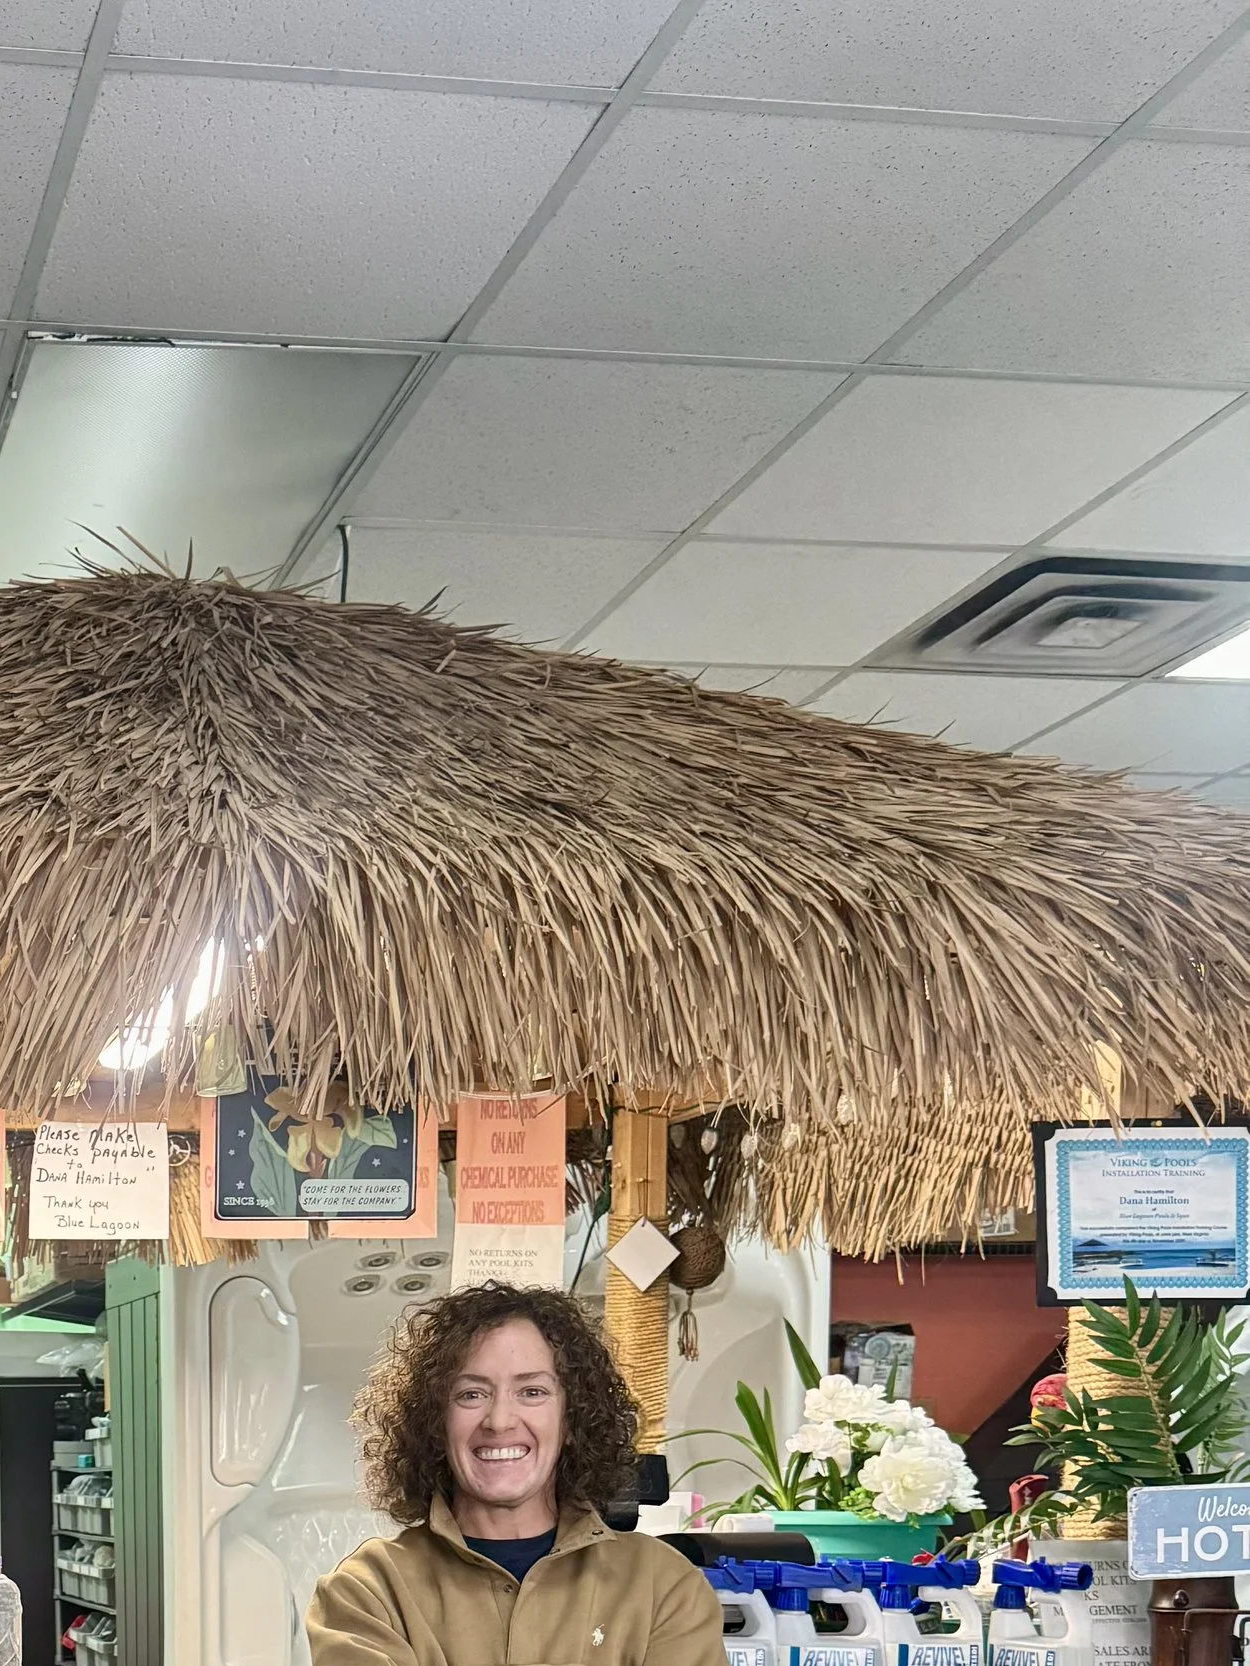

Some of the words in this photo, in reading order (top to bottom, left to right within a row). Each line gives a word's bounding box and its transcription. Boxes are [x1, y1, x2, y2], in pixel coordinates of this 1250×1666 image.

[480, 1099, 493, 1120] NO
[491, 1132, 506, 1154] ON
[507, 1131, 526, 1154] ANY
[67, 1159, 83, 1169] to
[1110, 1157, 1148, 1167] VIKING
[1164, 1157, 1198, 1167] POOLS
[460, 1165, 507, 1189] CHEMICAL
[507, 1164, 558, 1189] PURCHASE
[1102, 1169, 1161, 1177] INSTALLATION
[1163, 1168, 1206, 1177] TRAINING
[330, 1185, 346, 1194] FOR
[348, 1185, 363, 1194] THE
[223, 1197, 254, 1206] SINCE
[303, 1197, 322, 1206] STAY
[323, 1197, 340, 1206] FOR
[342, 1196, 357, 1206] THE
[1119, 1196, 1143, 1205] Dana
[1145, 1195, 1190, 1205] Hamilton
[88, 1200, 109, 1214] you
[472, 1200, 486, 1224] NO
[487, 1199, 545, 1224] EXCEPTIONS
[54, 1215, 85, 1228] Blue
[469, 1249, 482, 1257] NO
[483, 1249, 523, 1257] RETURNS
[468, 1259, 486, 1267] ANY
[488, 1259, 512, 1267] POOL
[513, 1259, 534, 1267] KITS
[911, 1646, 967, 1666] REVIVE!
[1094, 1645, 1130, 1657] SALES
